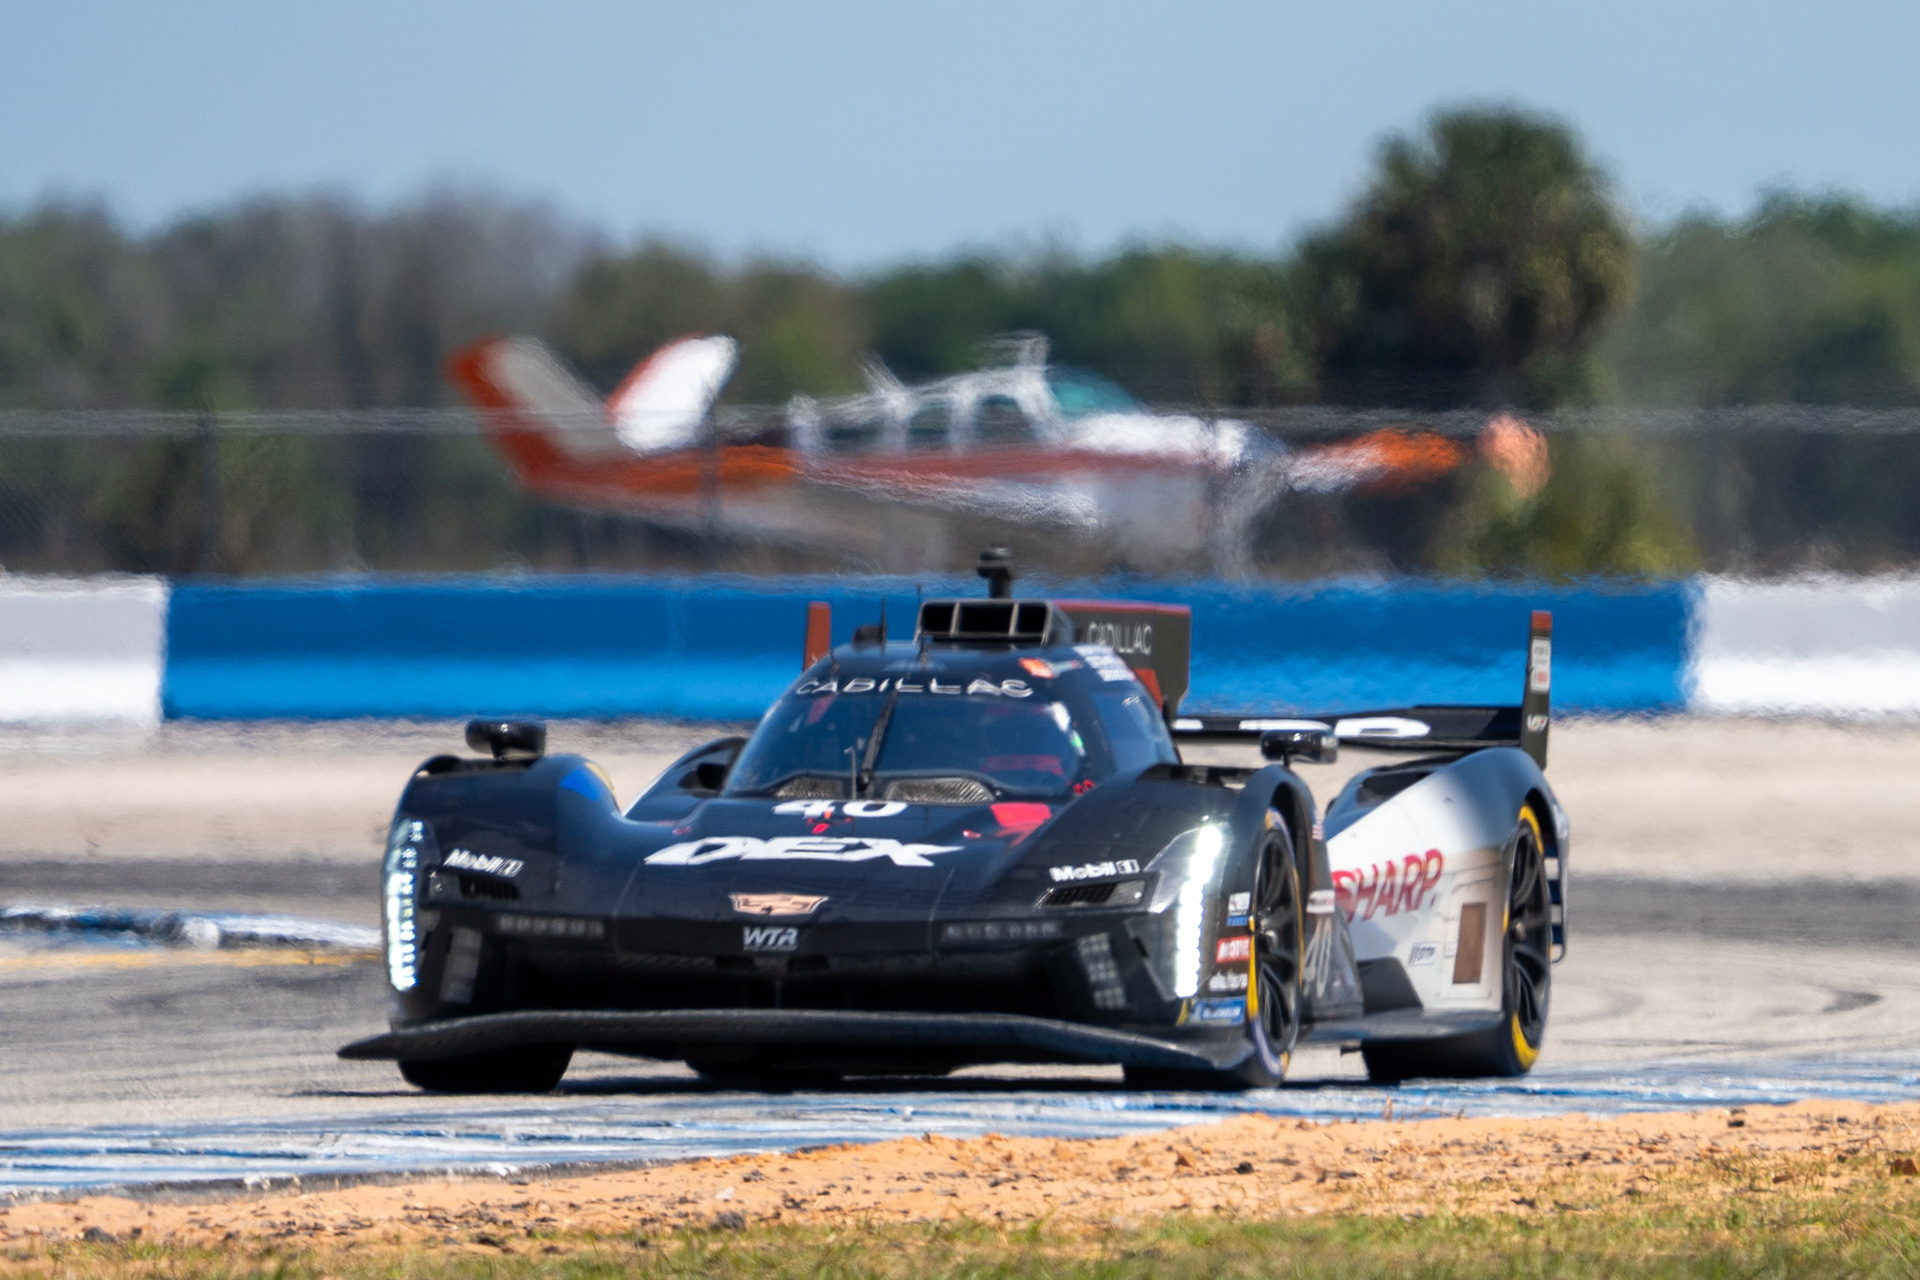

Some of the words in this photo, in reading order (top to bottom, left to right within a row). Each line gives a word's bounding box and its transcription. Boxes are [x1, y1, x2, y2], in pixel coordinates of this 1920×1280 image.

[797, 677, 1034, 698] CADILLAC
[773, 800, 908, 818] 40
[443, 848, 504, 873] Mobil
[1050, 861, 1116, 882] Mobil
[1332, 848, 1443, 924] SHARP
